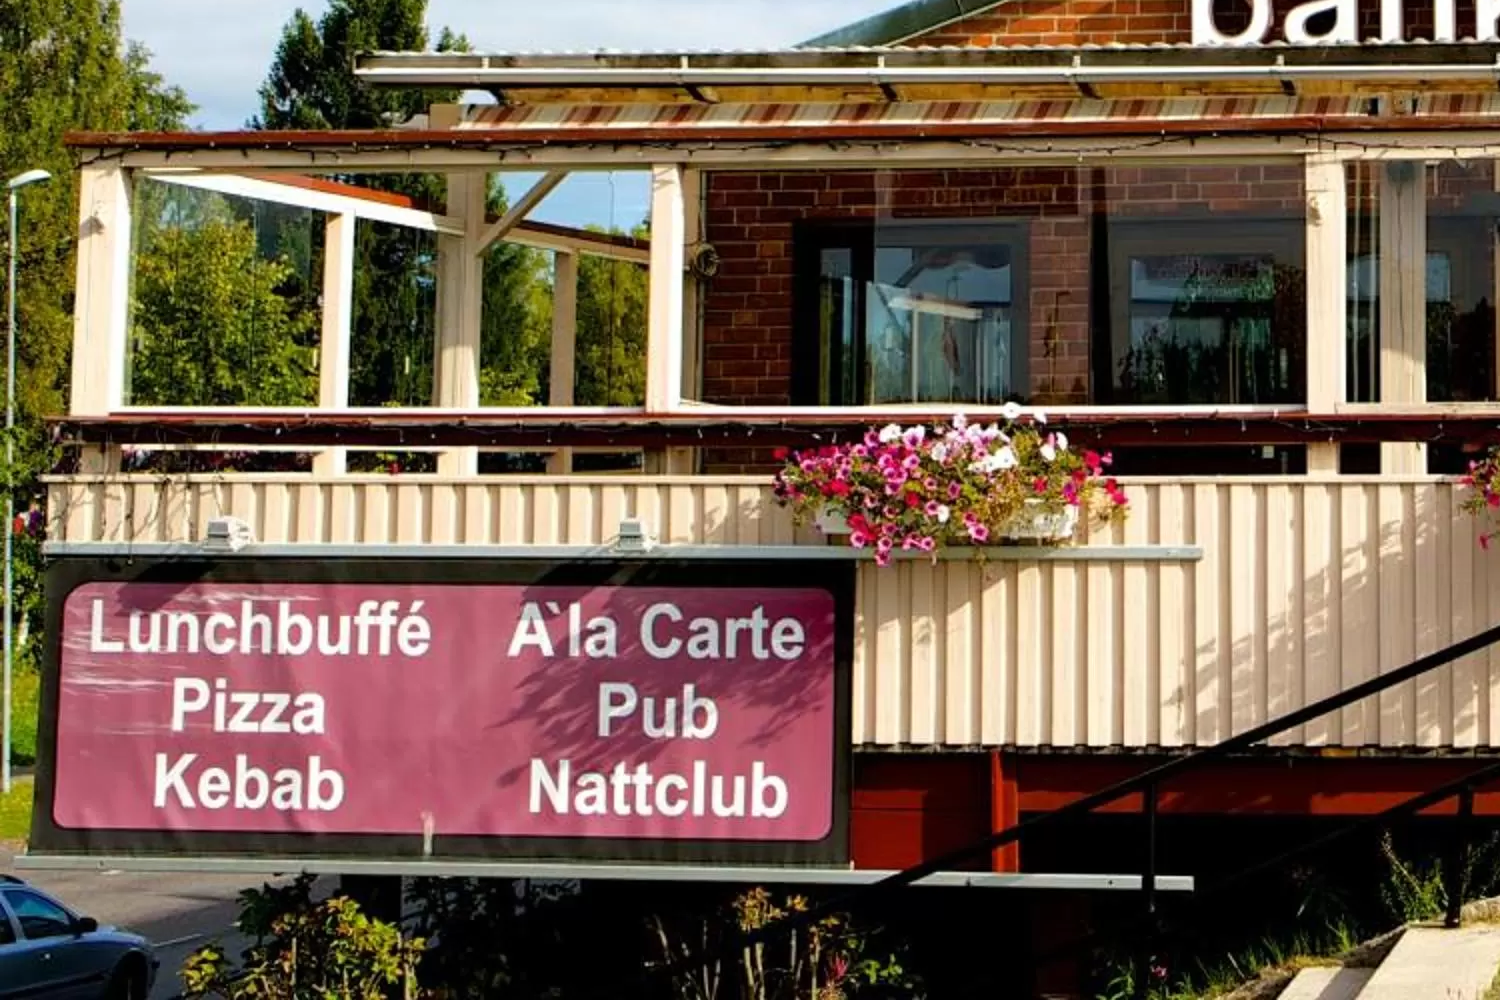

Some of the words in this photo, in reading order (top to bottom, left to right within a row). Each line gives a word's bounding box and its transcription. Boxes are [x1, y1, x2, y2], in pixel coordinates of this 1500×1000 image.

[90, 599, 432, 657] Lunchbuffé
[641, 603, 806, 660] Carte
[170, 677, 326, 735] Pizza
[597, 682, 719, 740] Pub
[154, 753, 345, 811] Kebab
[529, 758, 788, 818] Nattclub
